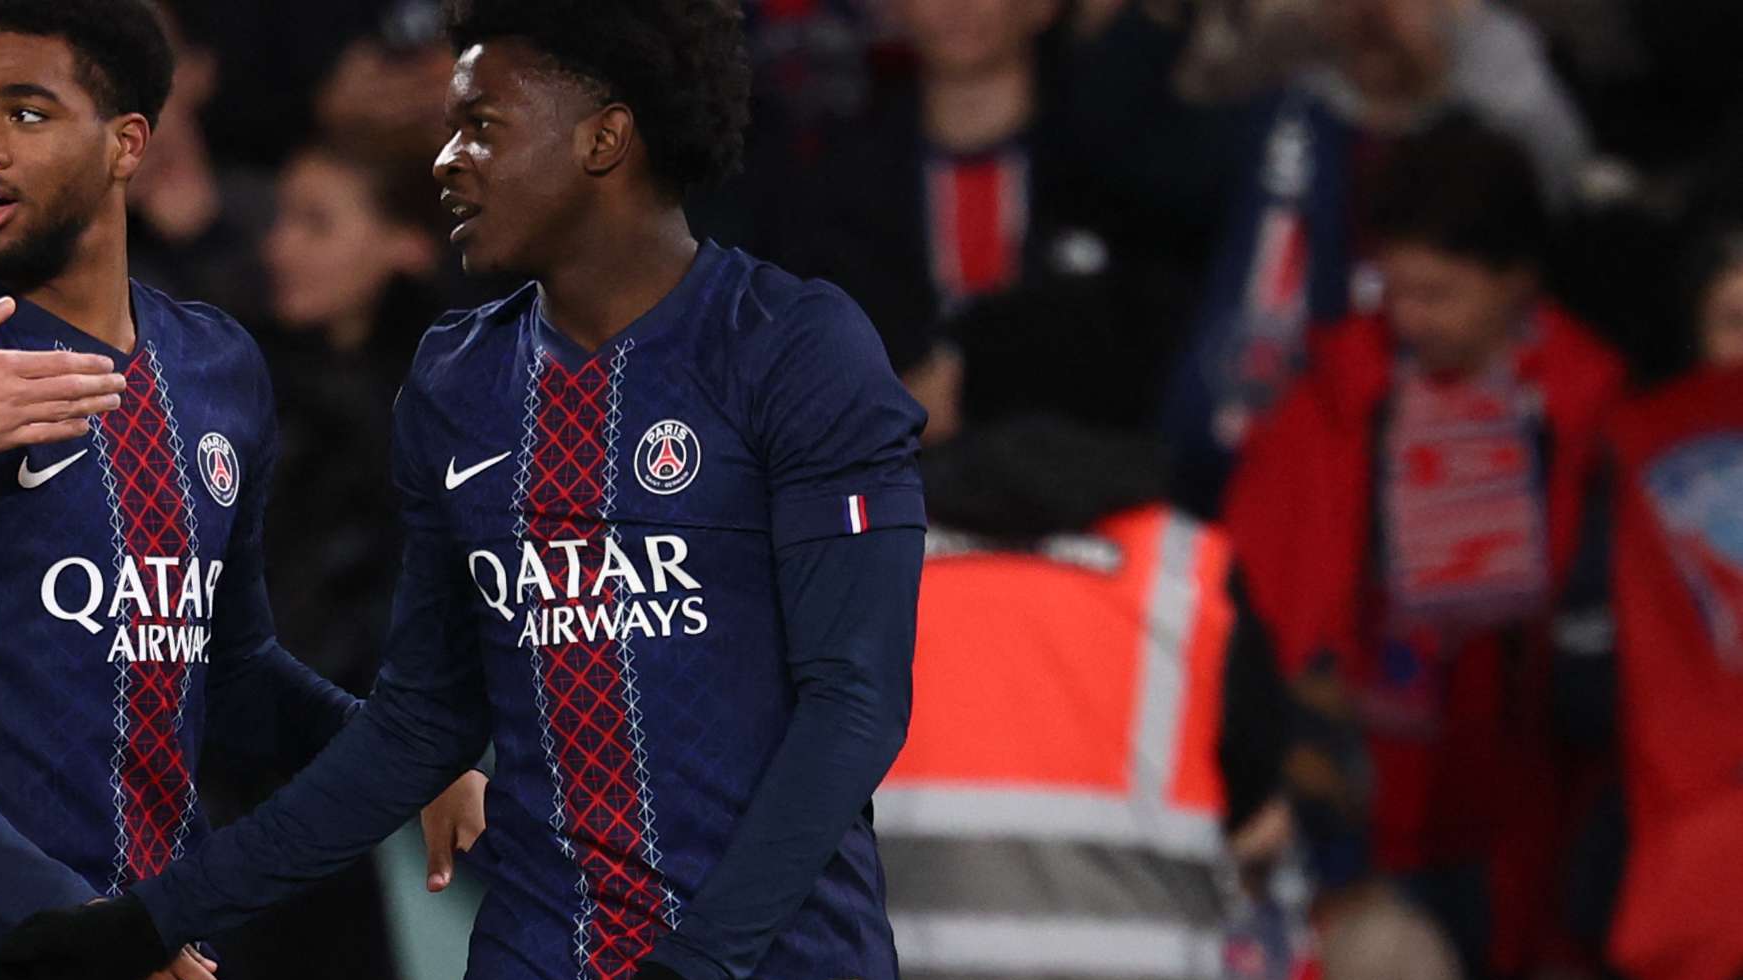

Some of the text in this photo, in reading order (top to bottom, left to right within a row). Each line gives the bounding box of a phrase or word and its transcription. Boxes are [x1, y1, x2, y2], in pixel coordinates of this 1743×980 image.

[201, 436, 229, 455] PARIS
[647, 424, 688, 444] PARIS
[468, 534, 702, 621] QATAR
[517, 596, 708, 648] AIRWAYS
